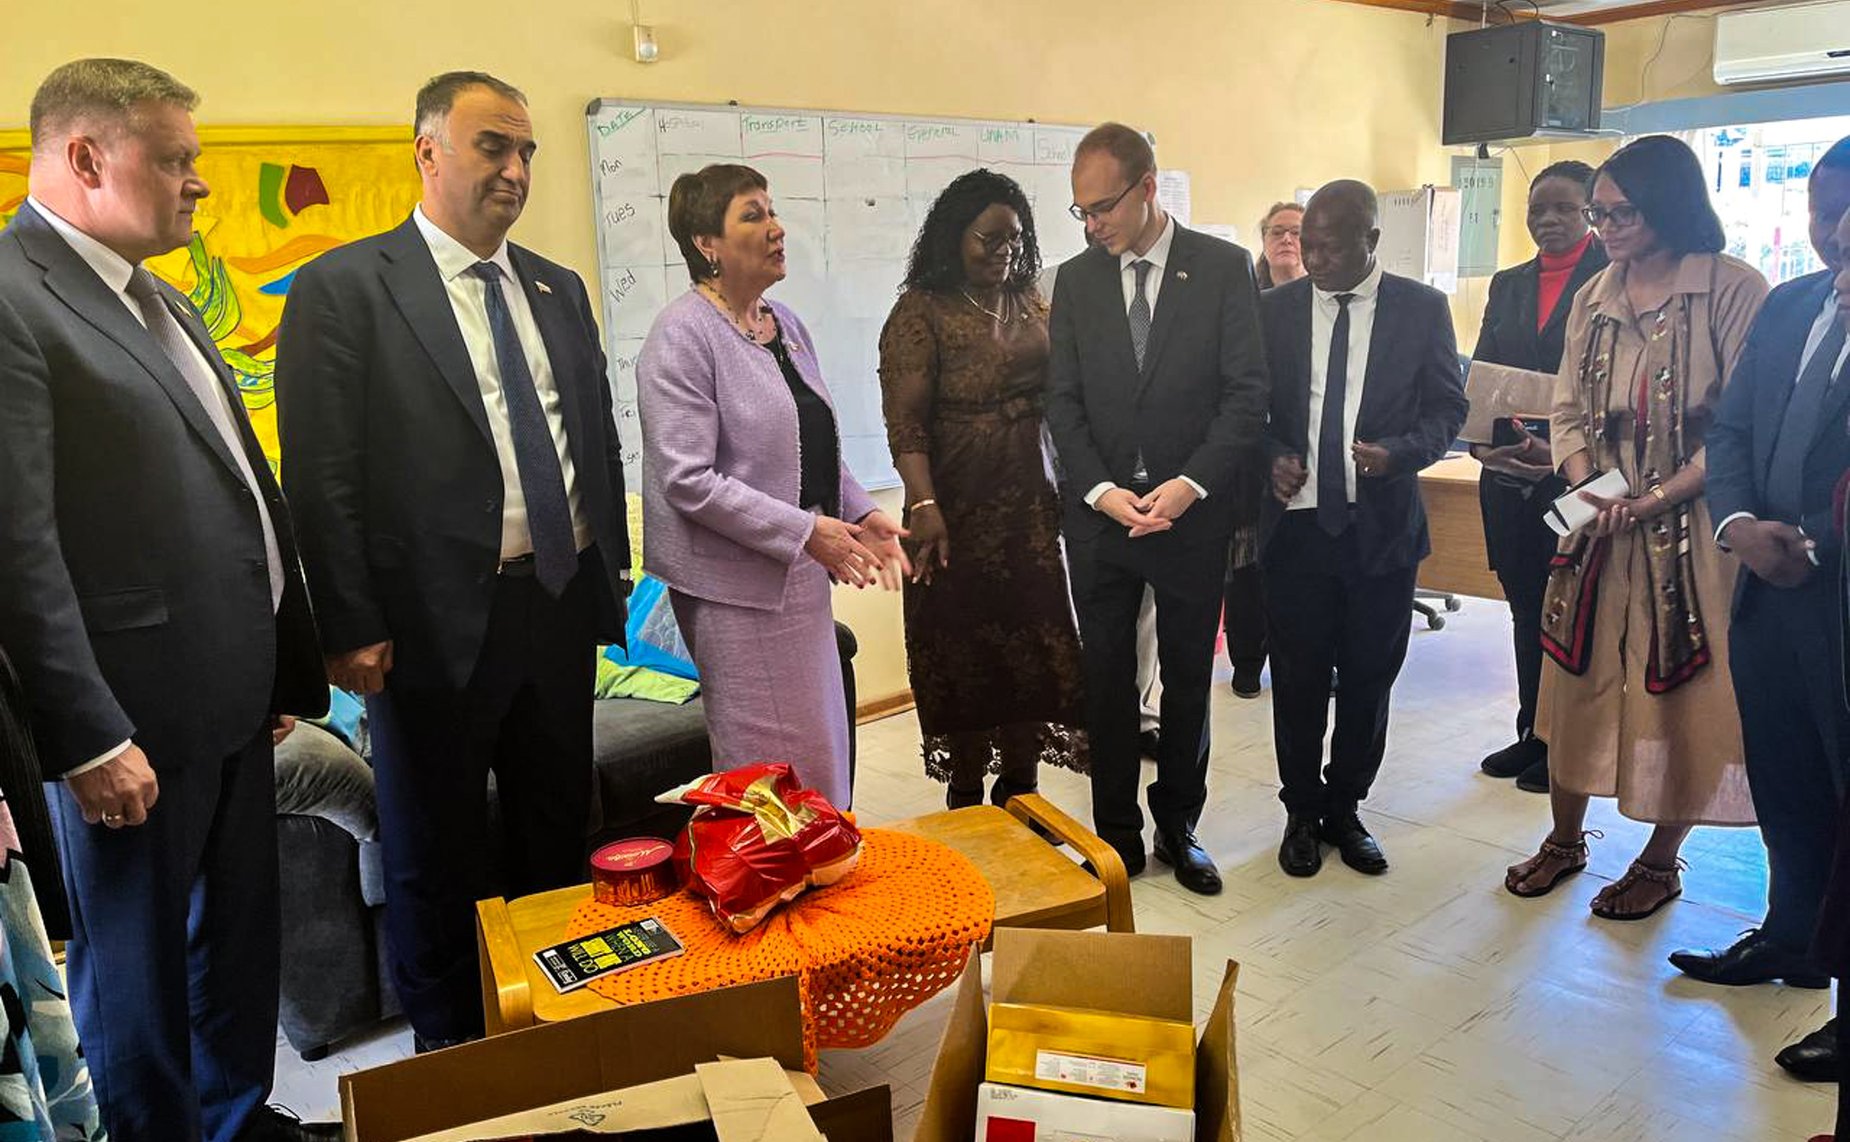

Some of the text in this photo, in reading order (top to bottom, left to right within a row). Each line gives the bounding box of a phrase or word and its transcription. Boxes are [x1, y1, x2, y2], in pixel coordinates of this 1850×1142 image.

[600, 159, 622, 176] Mon
[605, 203, 635, 228] Tues
[609, 268, 636, 303] Wed
[579, 957, 599, 974] DO
